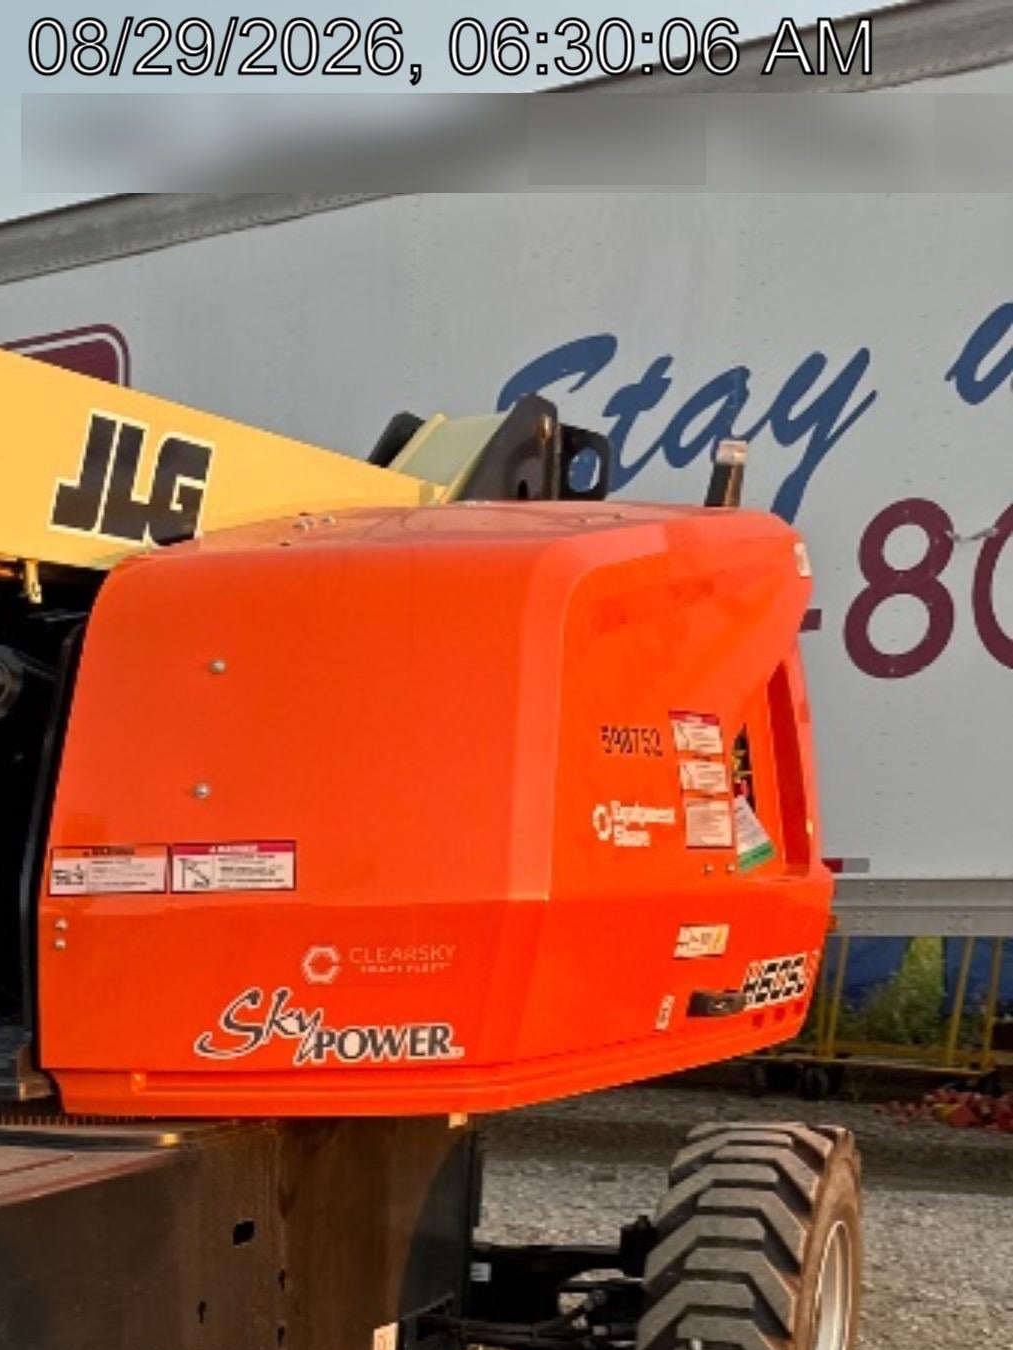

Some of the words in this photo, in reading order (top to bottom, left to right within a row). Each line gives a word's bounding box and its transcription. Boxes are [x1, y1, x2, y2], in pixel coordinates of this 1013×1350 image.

[47, 408, 216, 548] JLG
[496, 333, 877, 525] Stay
[348, 944, 457, 965] CLEARSKY
